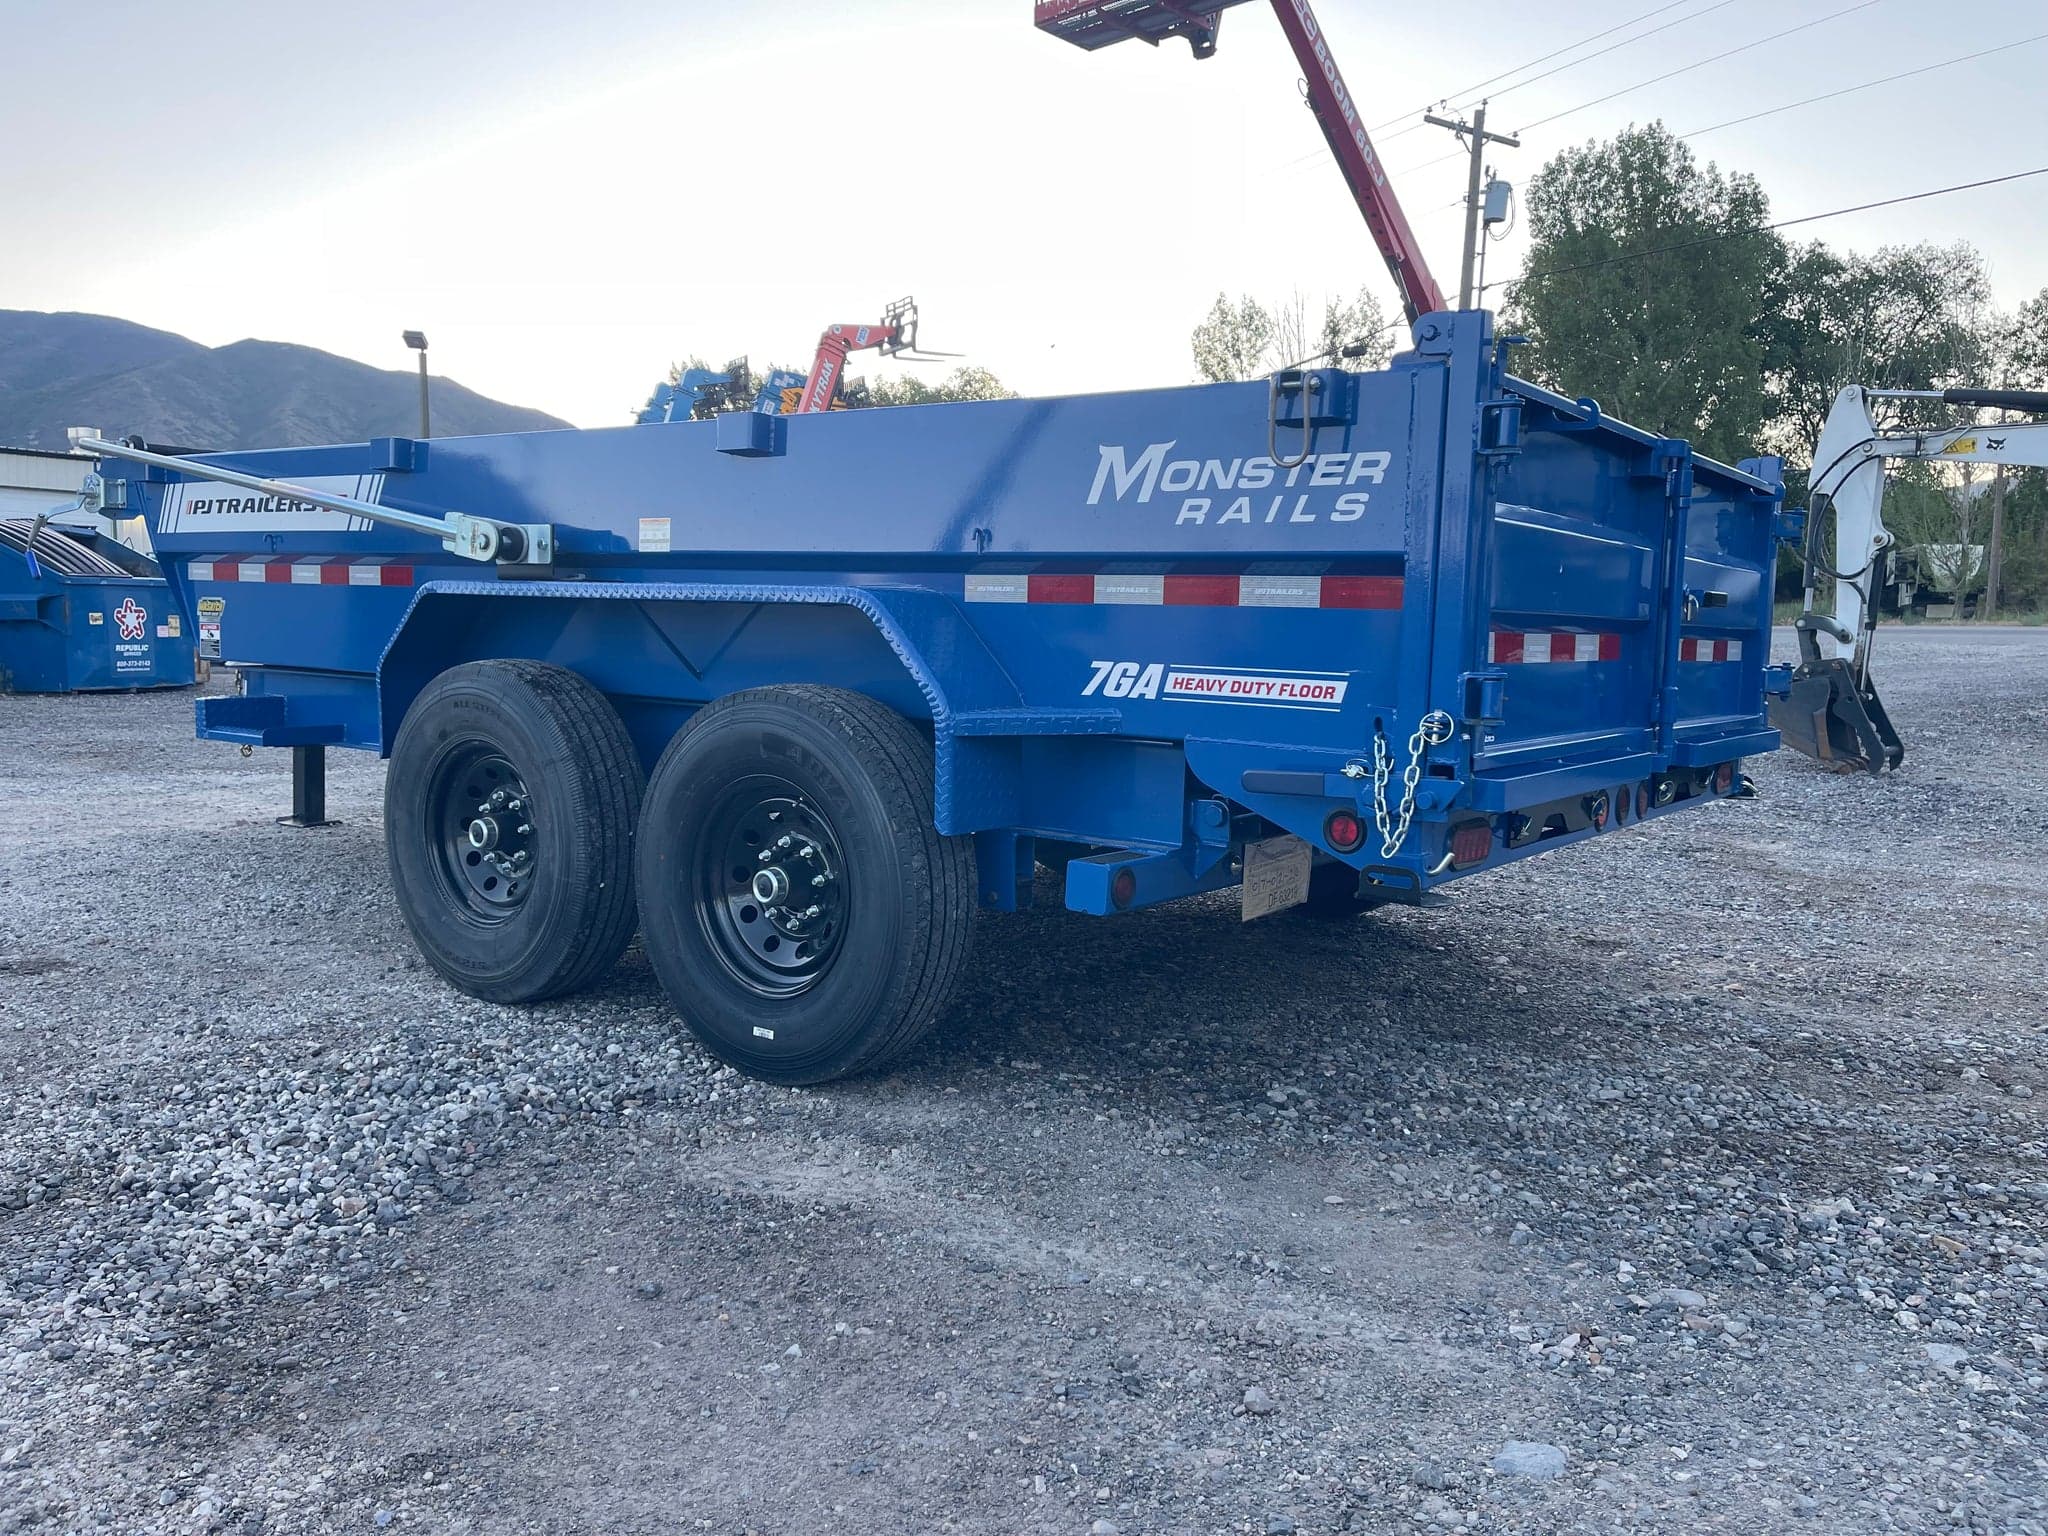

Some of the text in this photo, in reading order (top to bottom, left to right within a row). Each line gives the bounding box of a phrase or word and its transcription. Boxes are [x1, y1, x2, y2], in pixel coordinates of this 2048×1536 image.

[1315, 38, 1384, 186] BOOM 60-J
[1086, 439, 1391, 505] MONSTER
[1175, 492, 1370, 526] RAILS
[115, 644, 149, 652] REPUBLIC
[1080, 660, 1336, 700] 7GA HEAVY DUTY FLOOR
